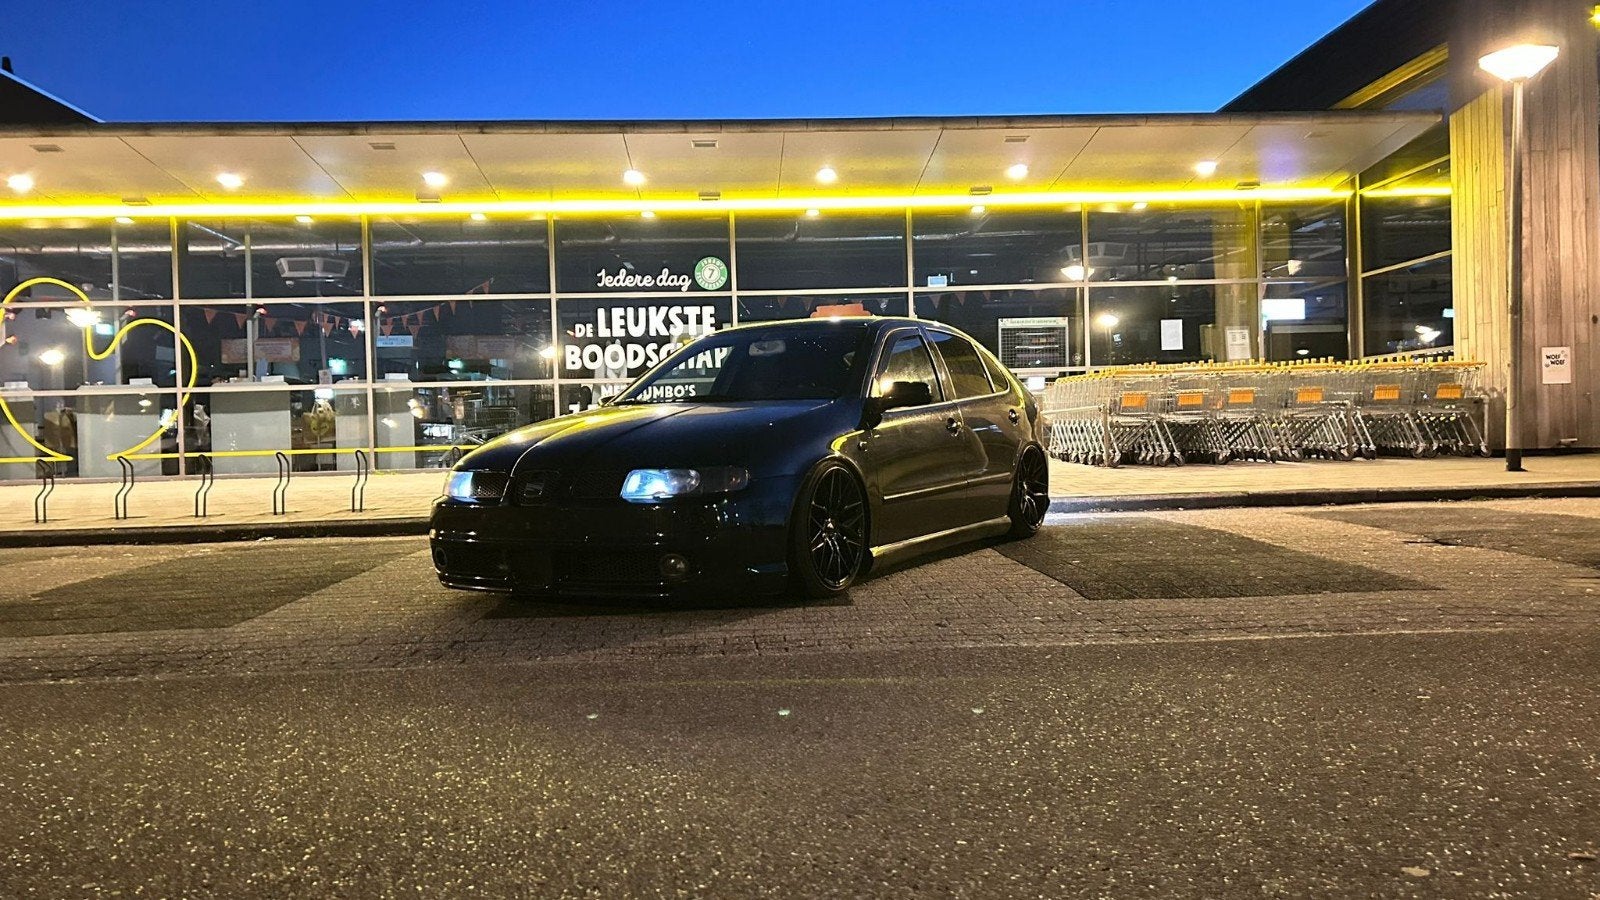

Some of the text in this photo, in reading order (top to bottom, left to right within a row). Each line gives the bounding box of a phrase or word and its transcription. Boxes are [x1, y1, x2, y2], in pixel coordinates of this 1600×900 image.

[656, 267, 692, 292] dag
[708, 267, 715, 279] 7
[574, 305, 716, 338] DE LEUKSTE
